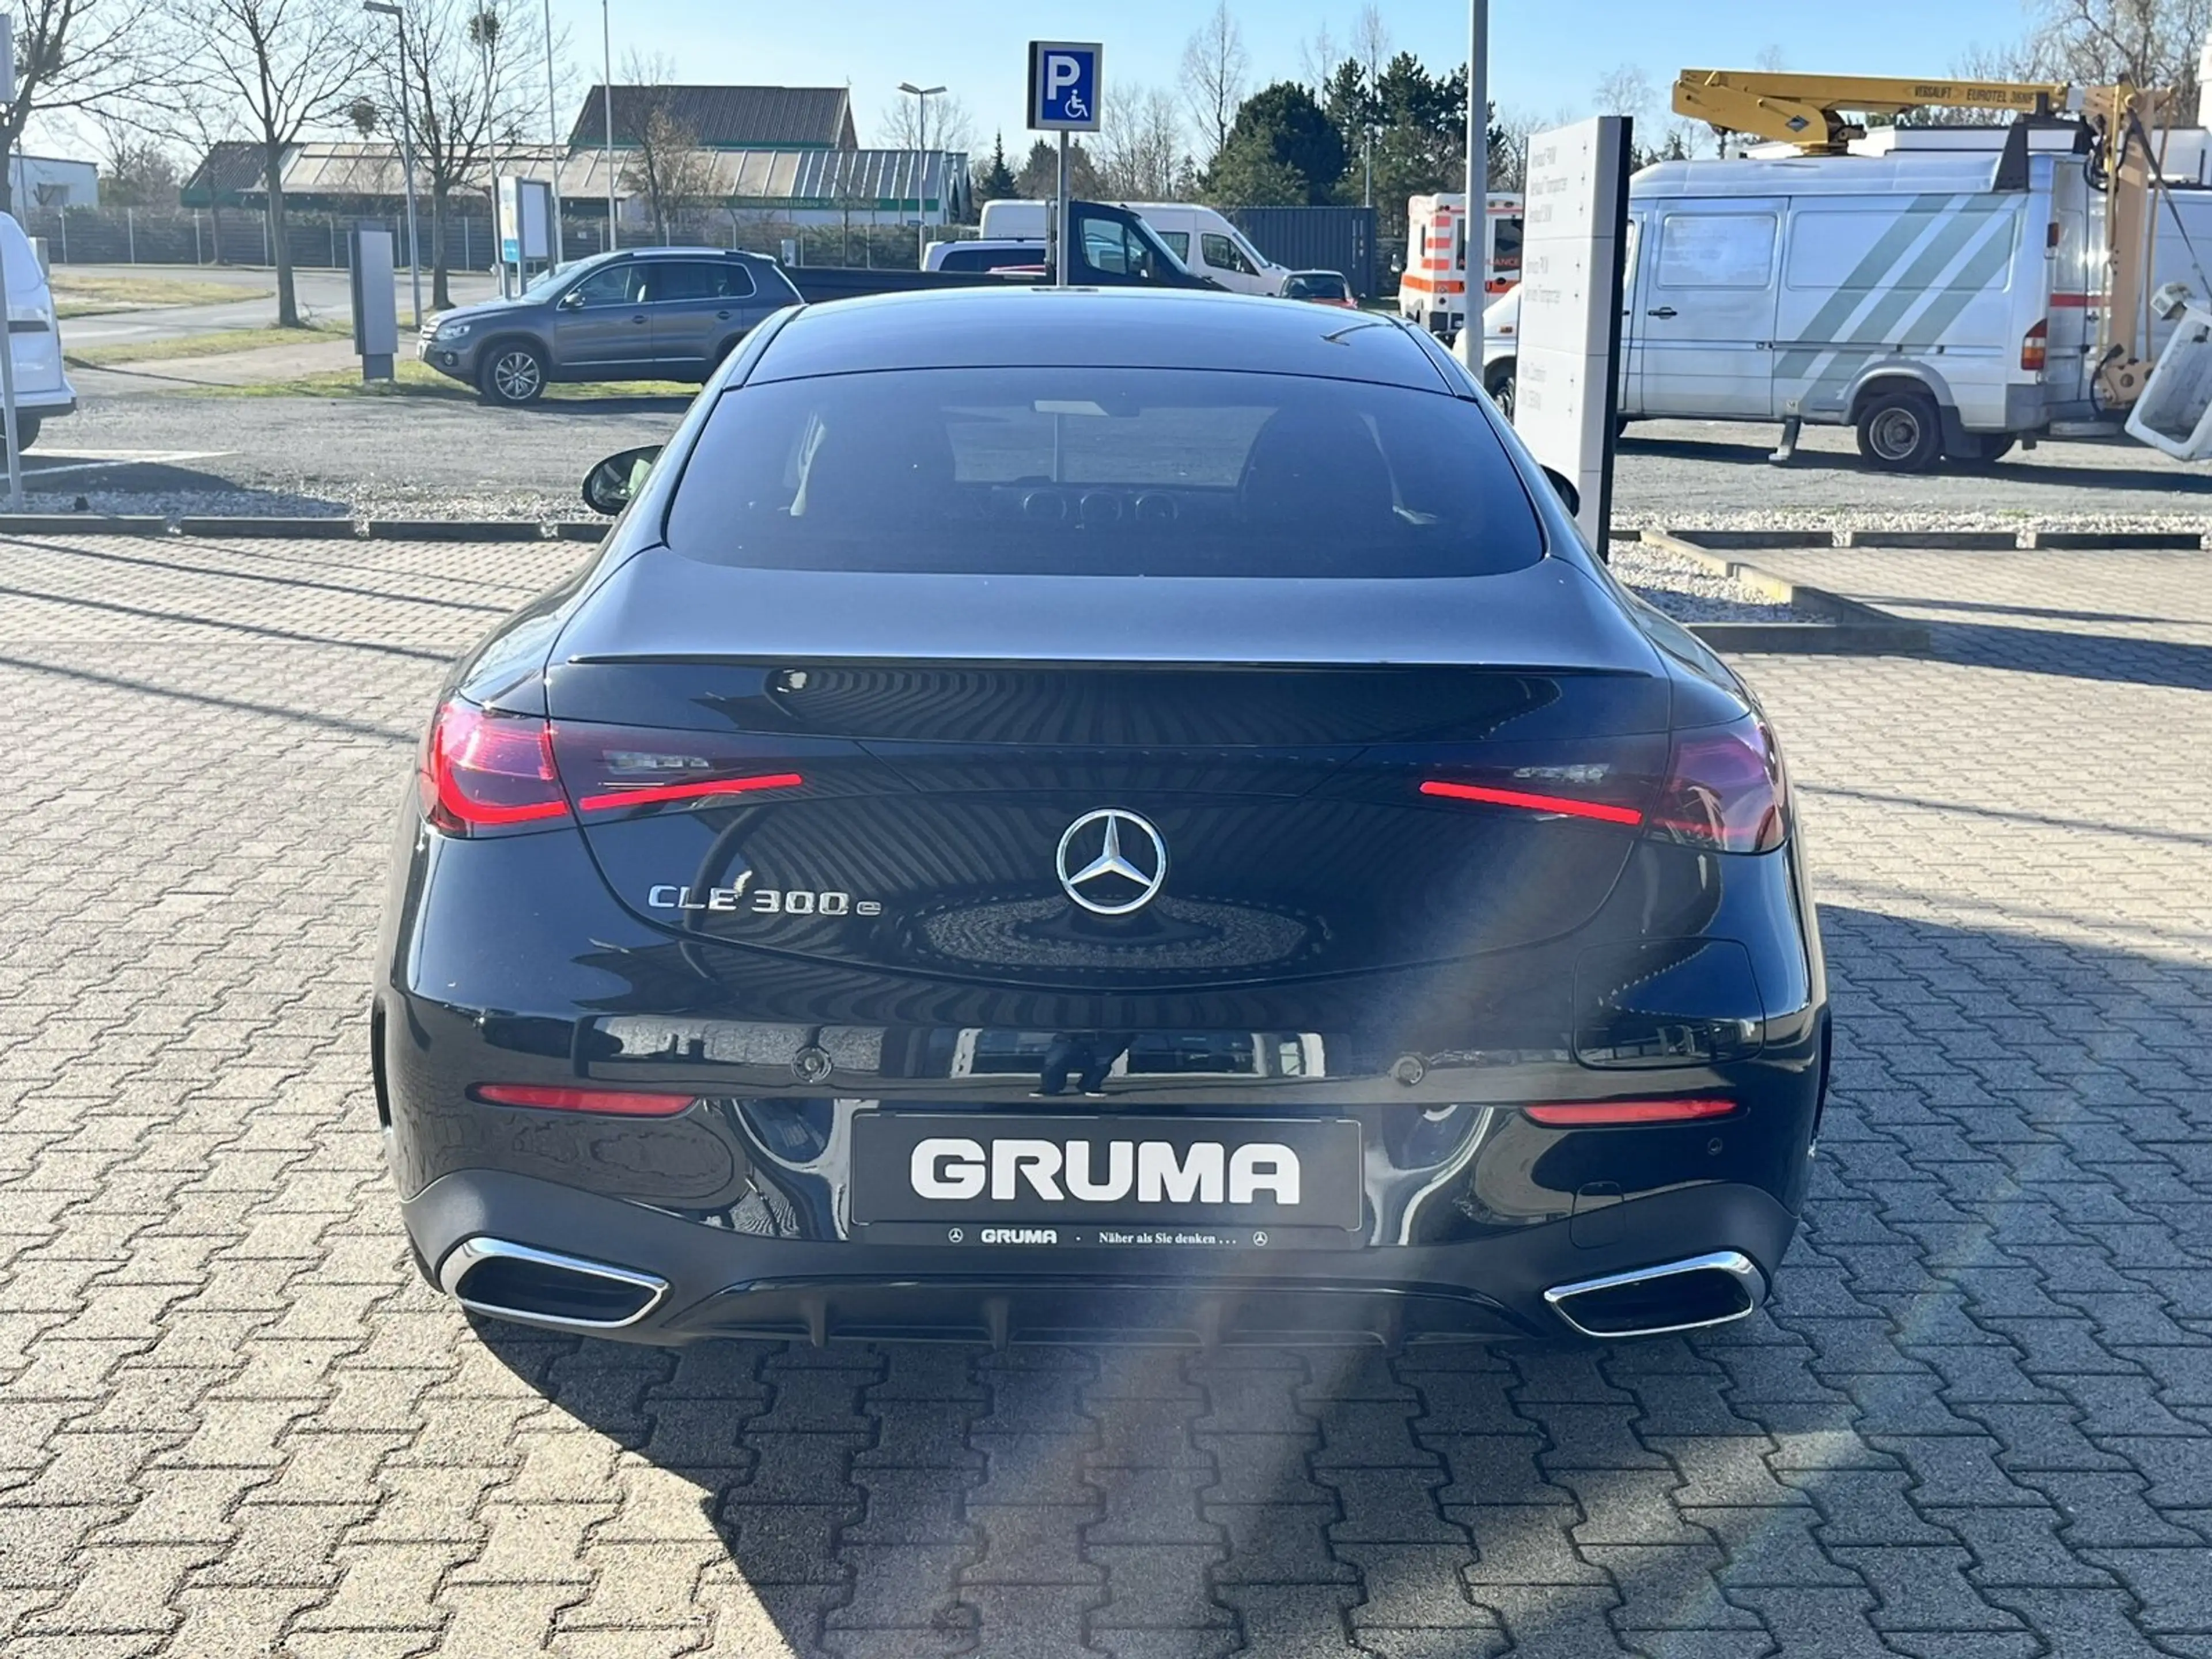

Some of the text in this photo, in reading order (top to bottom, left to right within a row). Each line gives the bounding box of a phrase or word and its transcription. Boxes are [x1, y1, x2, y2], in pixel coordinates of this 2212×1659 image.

[1047, 55, 1080, 100] P
[1967, 88, 2006, 103] EUROTEL
[648, 885, 737, 911] CLE
[911, 1138, 1300, 1205] GRUMA
[981, 1229, 1058, 1244] GRUMA
[1099, 1232, 1134, 1244] Näher
[1137, 1232, 1153, 1244] als
[1155, 1232, 1173, 1244] Sie
[1175, 1232, 1216, 1244] denken
